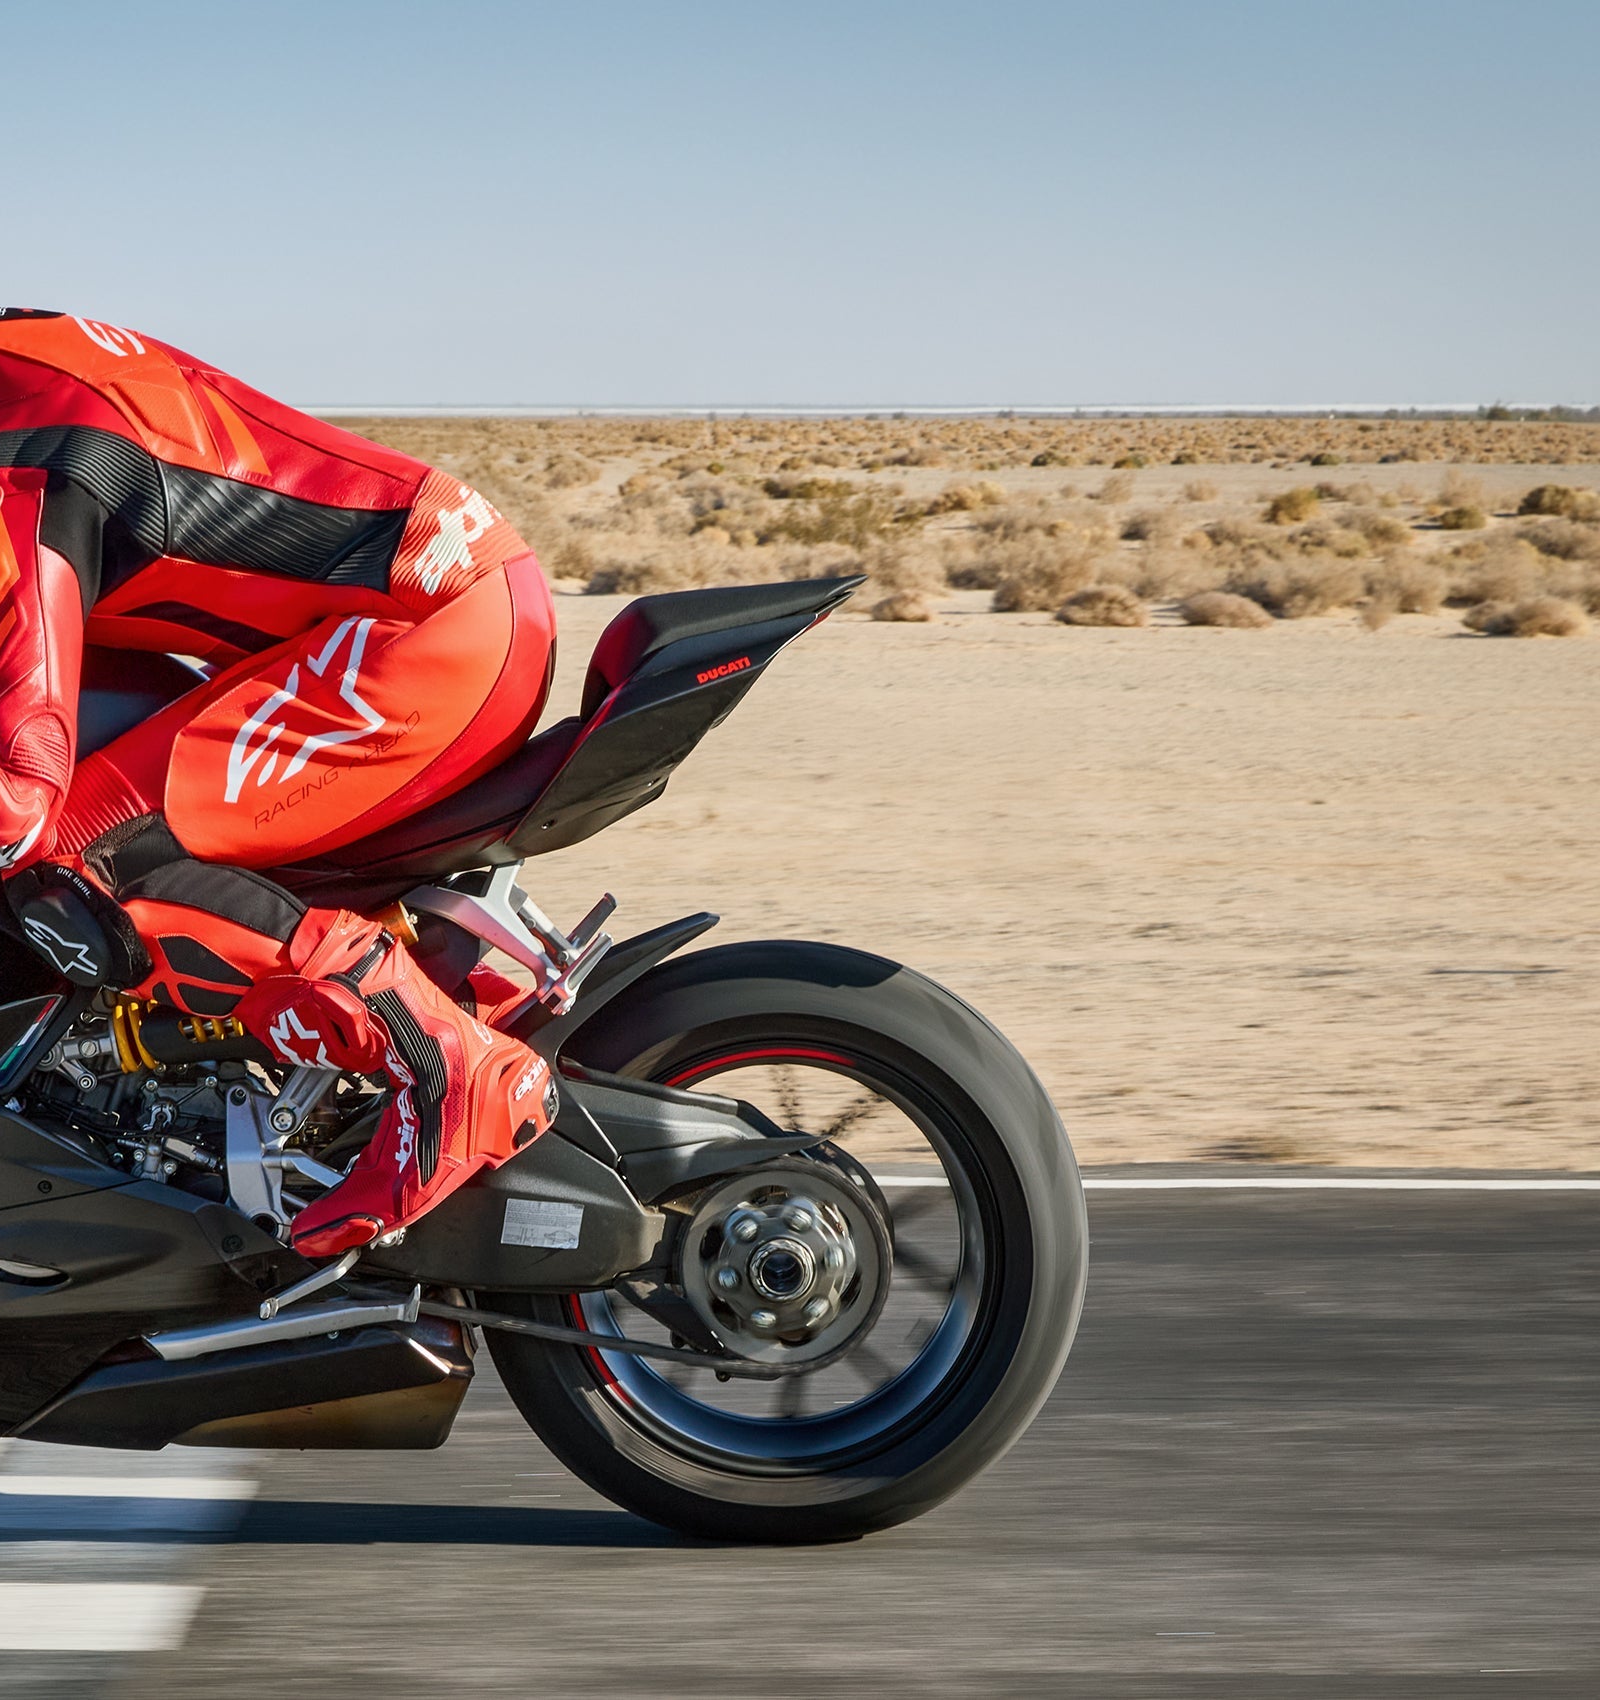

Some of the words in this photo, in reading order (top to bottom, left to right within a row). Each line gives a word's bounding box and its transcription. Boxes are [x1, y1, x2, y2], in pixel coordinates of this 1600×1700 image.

[697, 656, 751, 684] DUCATI
[254, 765, 339, 830] RACING
[348, 710, 420, 771] AHEAD
